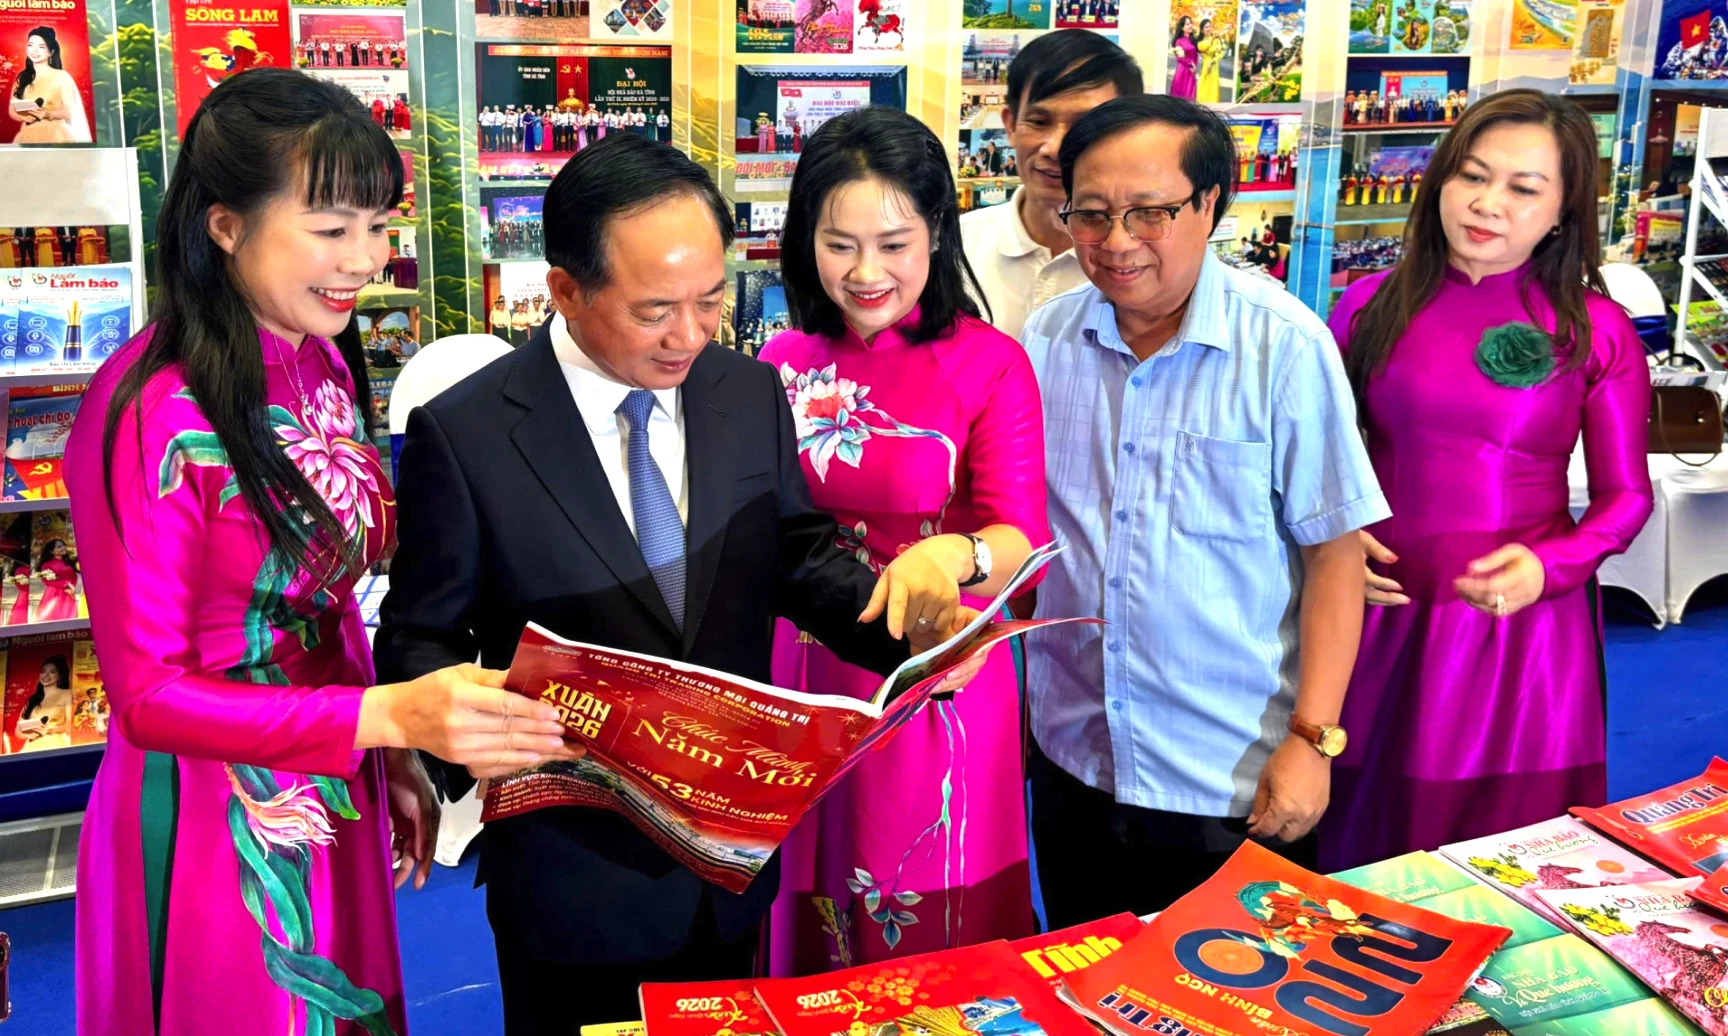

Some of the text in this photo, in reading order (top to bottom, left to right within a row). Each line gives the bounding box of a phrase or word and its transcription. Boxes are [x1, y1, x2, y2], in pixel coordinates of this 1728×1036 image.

[185, 6, 279, 22] SÔNG LAM
[616, 79, 647, 88] ĐẠI HỘI
[50, 277, 119, 288] Làm báo
[541, 679, 612, 723] XUÂN
[588, 653, 811, 725] TỔNG CÔNG TY THƯƠNG MẠI QUẢNG TRỊ
[600, 661, 640, 673] QUANG
[644, 671, 662, 679] TRI
[664, 677, 712, 697] TRADING
[713, 694, 791, 727] CORPORATION
[631, 717, 818, 788] Năm Mới
[661, 711, 814, 778] Chúc Mừng
[501, 777, 520, 788] LĨNH
[522, 773, 540, 782] VỰC
[649, 772, 694, 800] 53
[689, 795, 788, 821] KINH NGHIỆM
[694, 788, 731, 804] NĂM
[1020, 935, 1123, 979] Tĩnh
[675, 996, 723, 1012] 2026
[796, 989, 843, 1010] 2026
[1174, 972, 1274, 1020] BÍNH NGỌ
